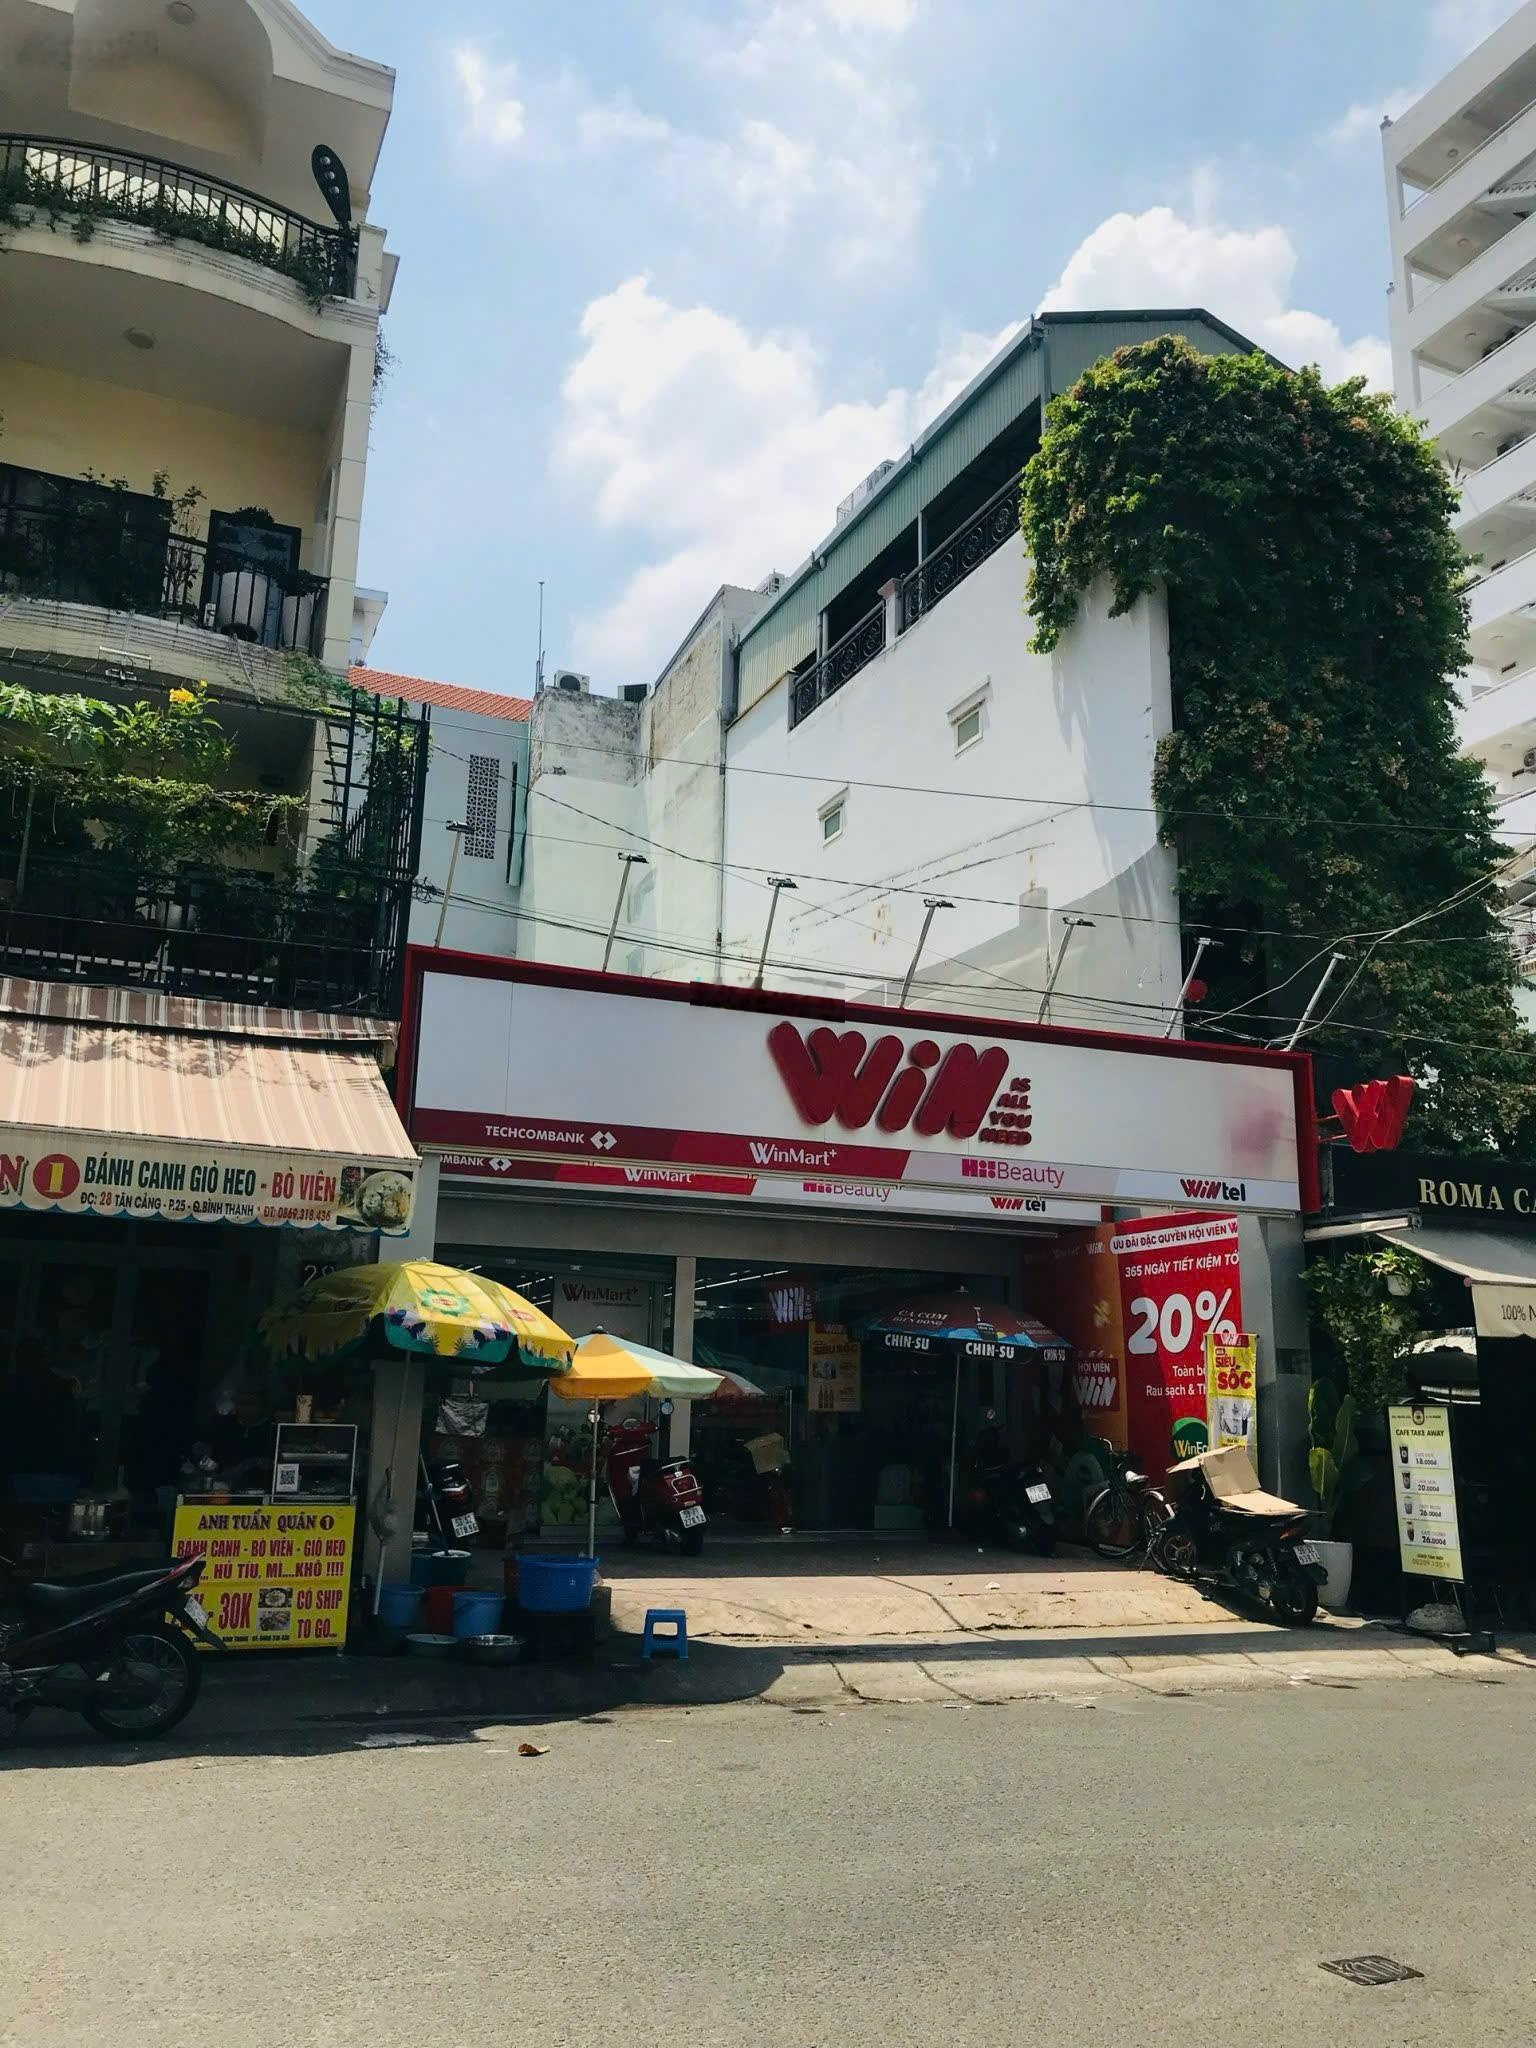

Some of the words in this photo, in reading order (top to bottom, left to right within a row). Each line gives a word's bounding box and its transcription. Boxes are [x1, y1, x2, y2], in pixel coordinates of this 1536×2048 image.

[1010, 1077, 1031, 1092] IS
[997, 1093, 1031, 1110] ALL
[989, 1110, 1032, 1128] YOU
[486, 1125, 585, 1144] TECHCOMBANK
[979, 1127, 1032, 1145] NEED
[84, 1151, 134, 1187] BÁNH
[138, 1160, 186, 1191] CANH
[190, 1160, 217, 1193] GIÒ
[223, 1167, 256, 1197] HEO
[272, 1166, 294, 1200] BÒ
[300, 1170, 337, 1203] VIÊN
[1419, 1178, 1505, 1211] ROMA
[80, 1191, 97, 1205] ĐC:
[100, 1191, 112, 1207] 28
[115, 1192, 133, 1208] TÂN
[134, 1195, 161, 1210] CẢNG
[169, 1198, 186, 1212] P.25
[225, 1203, 254, 1219] THẠNH
[1113, 1239, 1124, 1250] ƯU
[1125, 1237, 1139, 1249] ĐÃI
[1140, 1235, 1157, 1247] ĐẶC
[1158, 1230, 1187, 1243] QUYỀN
[1188, 1226, 1204, 1241] HỘI
[1206, 1223, 1227, 1237] VIÊN
[1124, 1265, 1142, 1278] 365
[1144, 1259, 1171, 1276] NGÀY
[1173, 1255, 1194, 1272] TIẾT
[1196, 1253, 1221, 1271] KIỆM
[1128, 1287, 1237, 1354] 20%
[1502, 1304, 1526, 1321] 100%
[885, 1332, 930, 1350] CHIN-SU
[965, 1341, 1015, 1360] CHIN-SU
[1043, 1348, 1066, 1361] CHIN-SU
[1093, 1360, 1111, 1373] VIÊN
[1215, 1353, 1236, 1368] SIÊU
[1172, 1364, 1194, 1377] Toàn
[1146, 1384, 1163, 1397] Rau
[1165, 1383, 1186, 1399] sạch
[1395, 1429, 1410, 1437] CAFE
[1411, 1429, 1425, 1437] TAKE
[198, 1514, 229, 1531] ANH
[232, 1508, 272, 1530] TUẤN
[211, 1539, 241, 1557] CANH
[270, 1537, 294, 1557] VIÊN
[326, 1539, 347, 1557] HEO
[218, 1592, 253, 1630] 30K
[297, 1586, 313, 1610] CÓ
[316, 1589, 343, 1610] SHIP
[297, 1619, 311, 1639] TO
